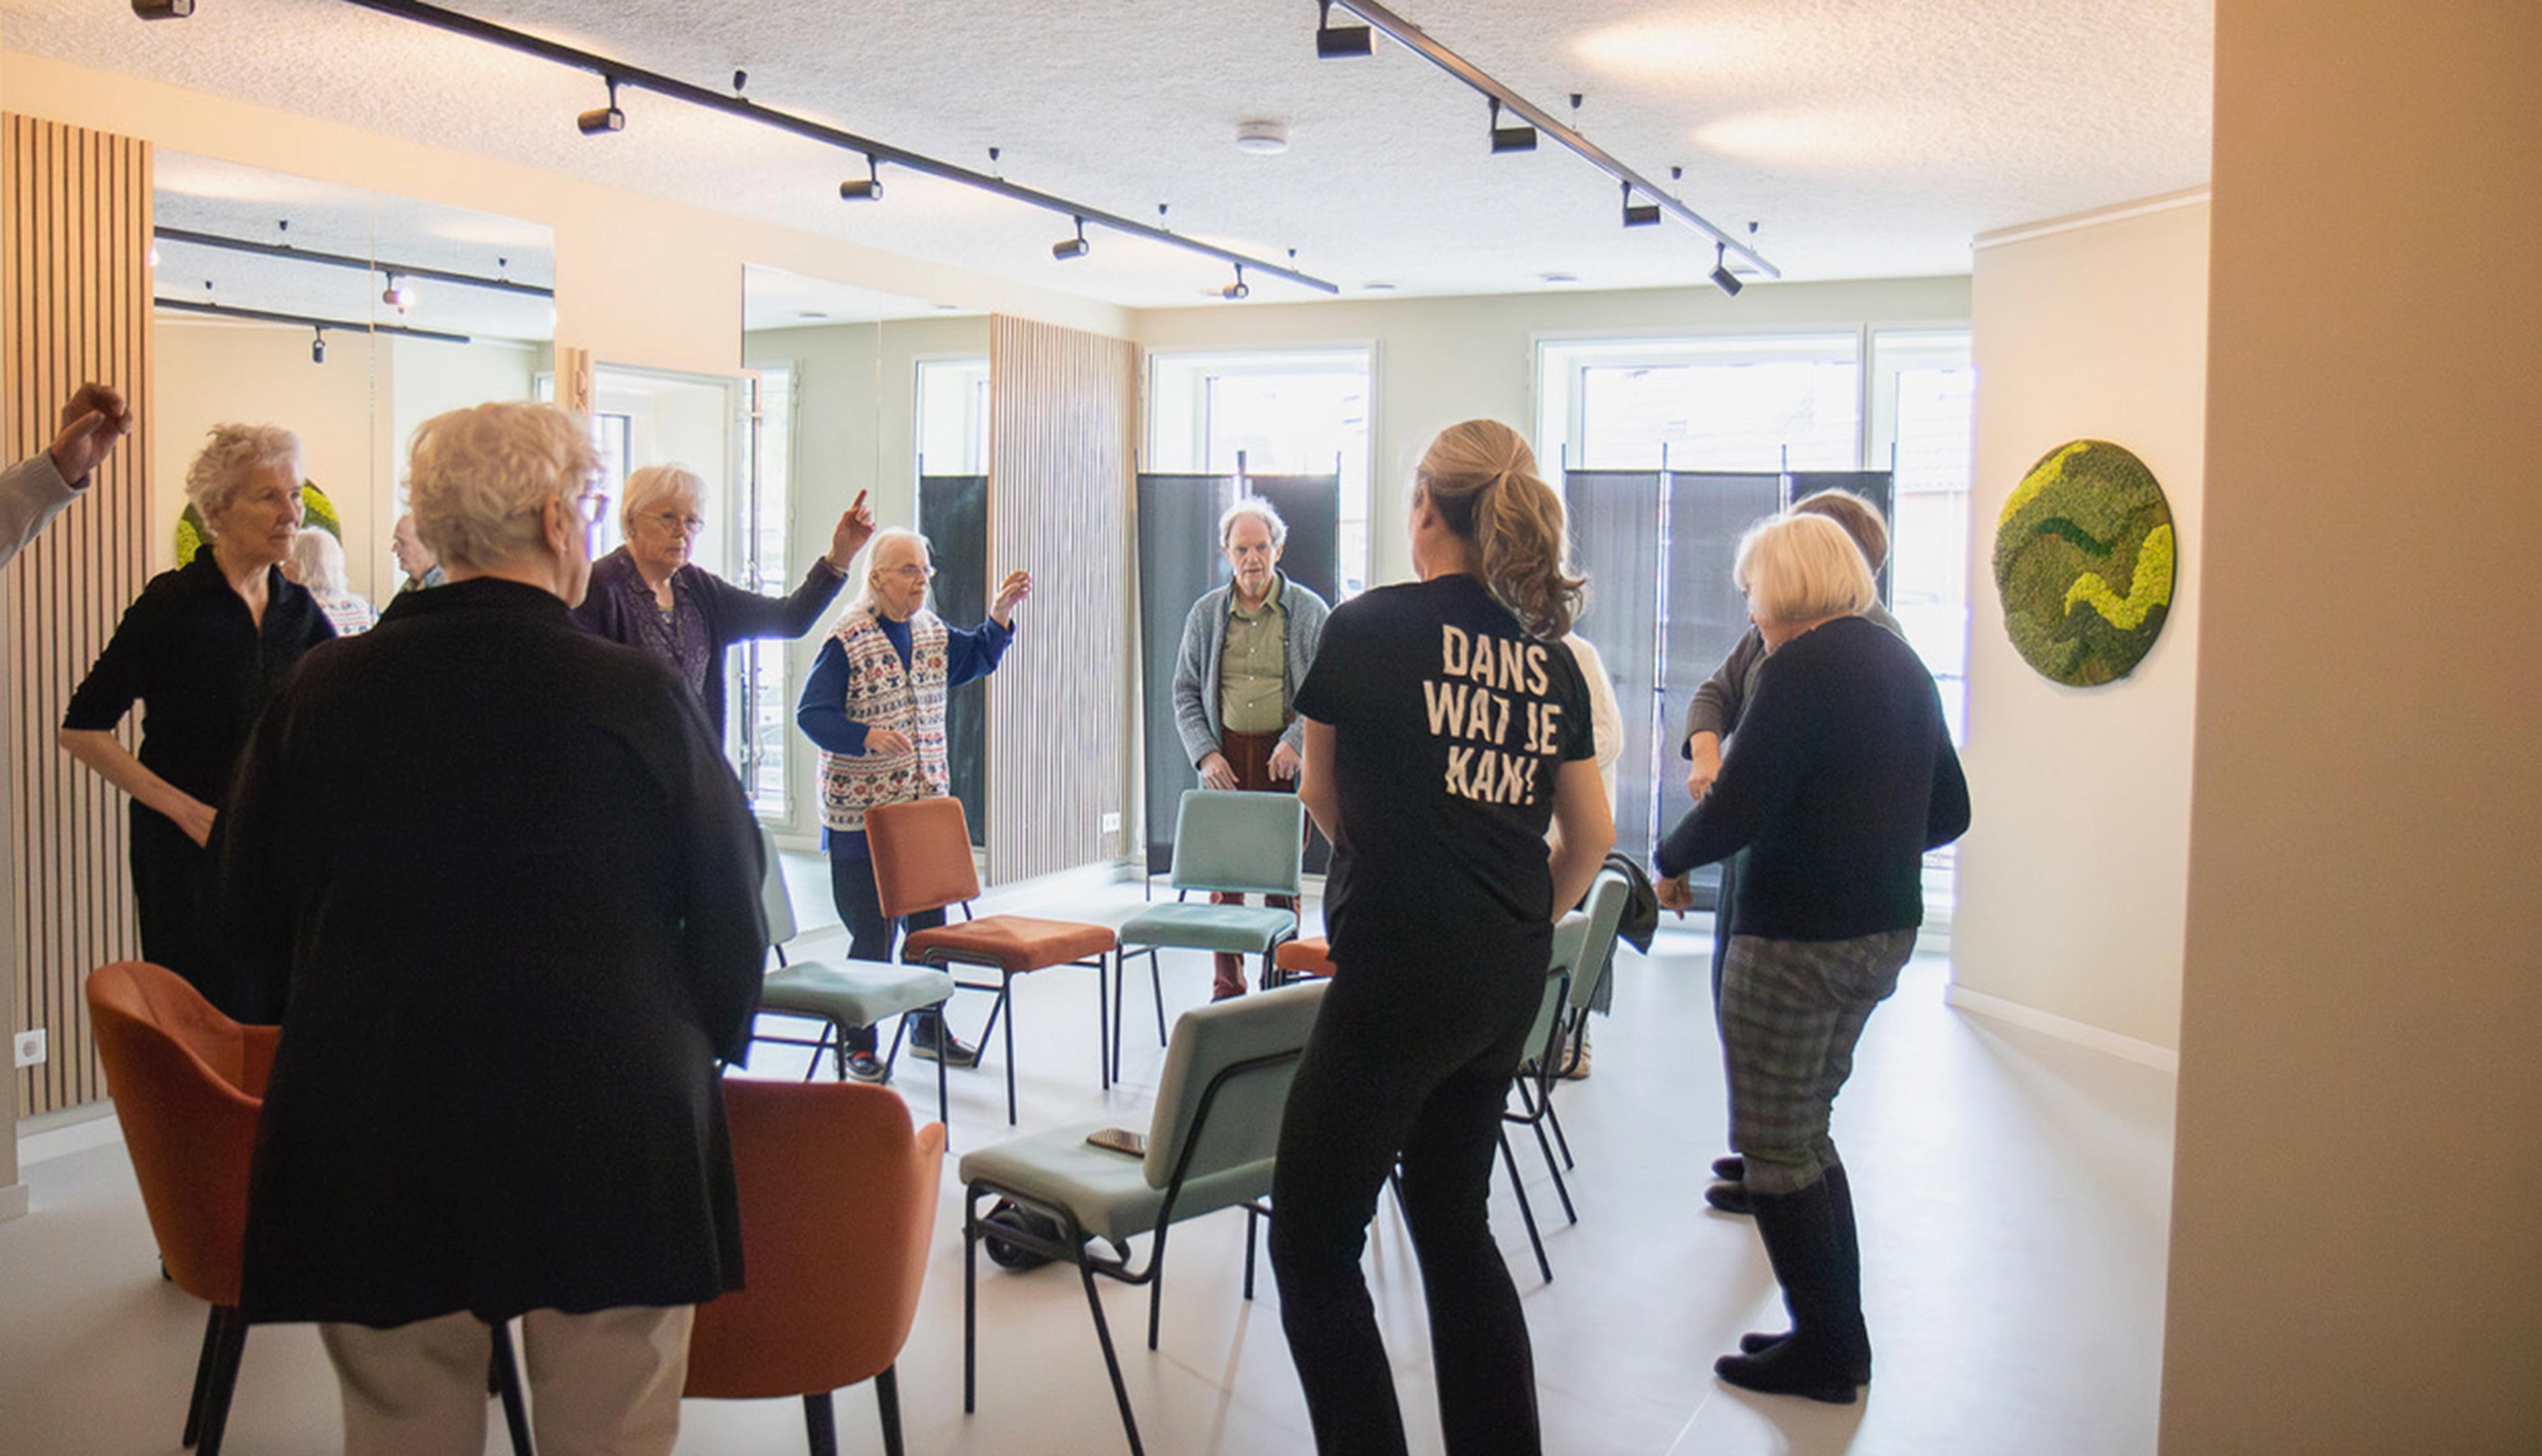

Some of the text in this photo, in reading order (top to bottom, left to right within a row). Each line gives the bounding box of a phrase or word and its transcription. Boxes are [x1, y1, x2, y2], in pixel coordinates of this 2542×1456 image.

[1443, 623, 1549, 696] DANS
[1422, 680, 1561, 754] WAT JE
[1445, 746, 1538, 805] KAN!
